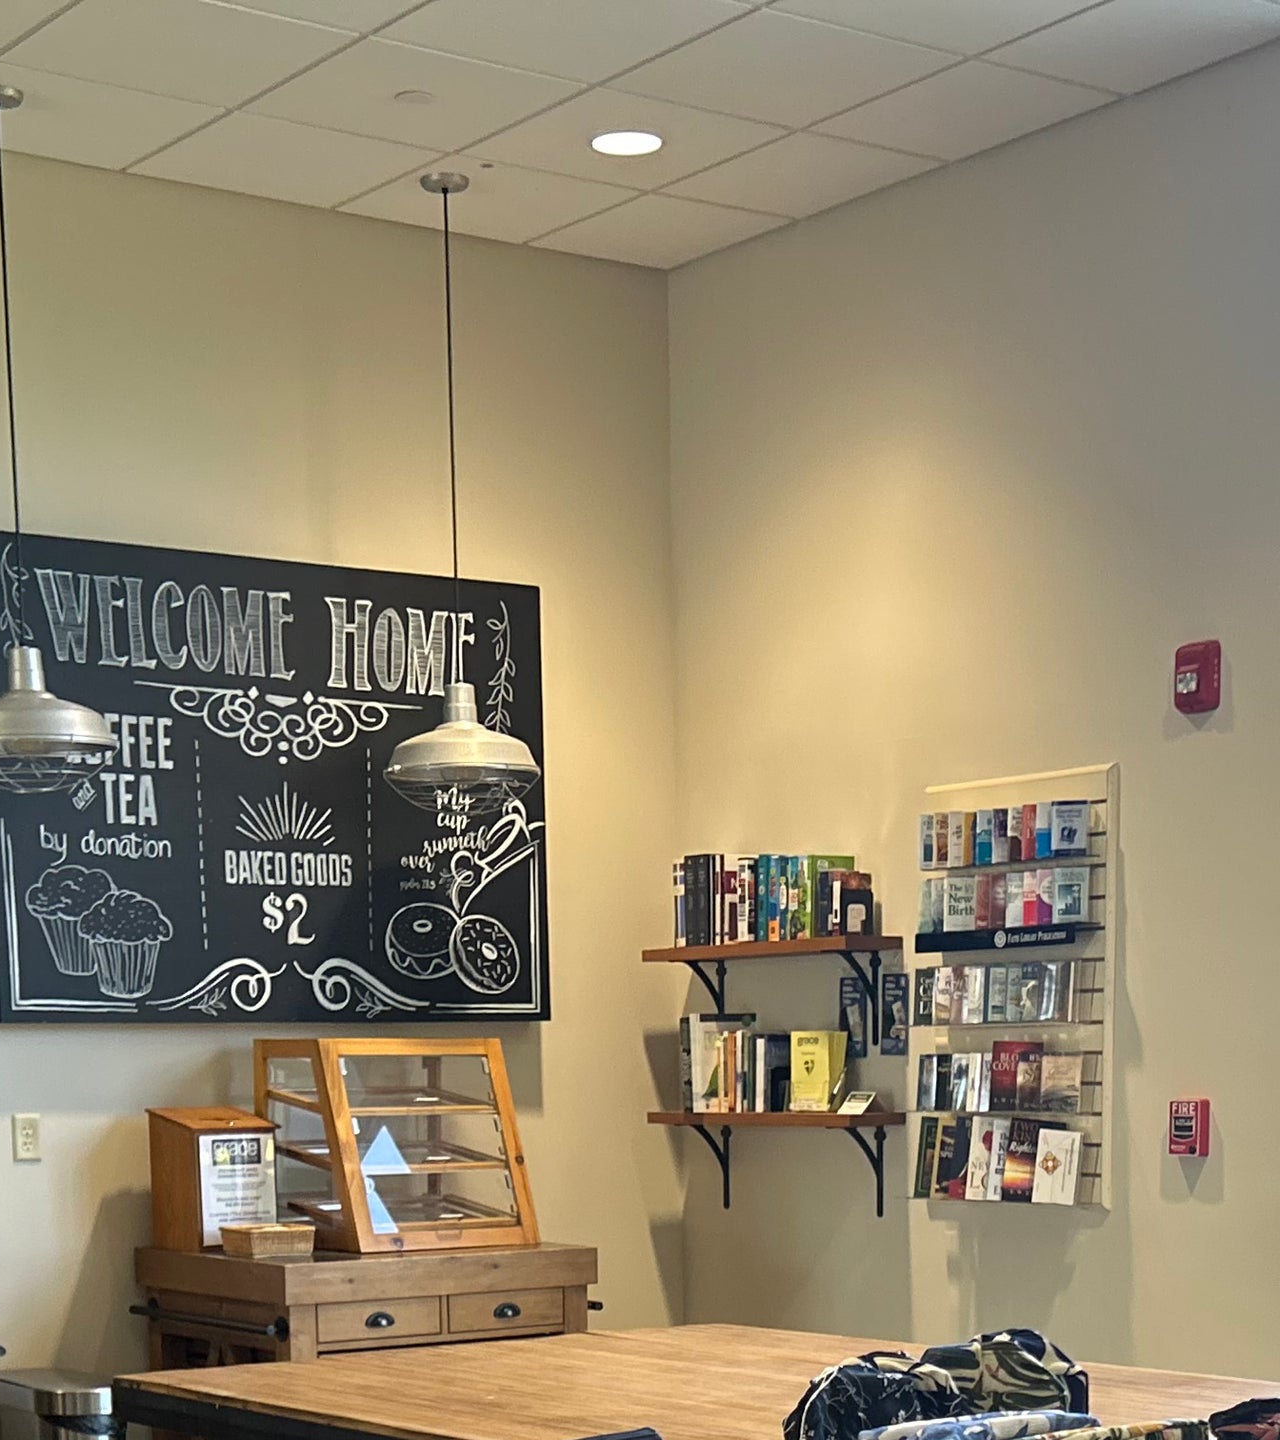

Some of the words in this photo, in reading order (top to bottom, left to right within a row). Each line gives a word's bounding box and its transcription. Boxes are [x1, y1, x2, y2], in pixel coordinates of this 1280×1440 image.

[33, 567, 295, 681] WELCOME
[67, 713, 174, 769] FFEE
[99, 773, 158, 826] TEA
[422, 825, 491, 858] runneth
[437, 812, 470, 835] cup
[39, 824, 67, 866] by
[81, 829, 172, 859] donation
[400, 854, 435, 873] over
[224, 850, 285, 887] BAKED
[290, 852, 352, 887] GOODS
[948, 893, 973, 904] New
[263, 892, 316, 946] $2
[1172, 1102, 1196, 1114] FIRE
